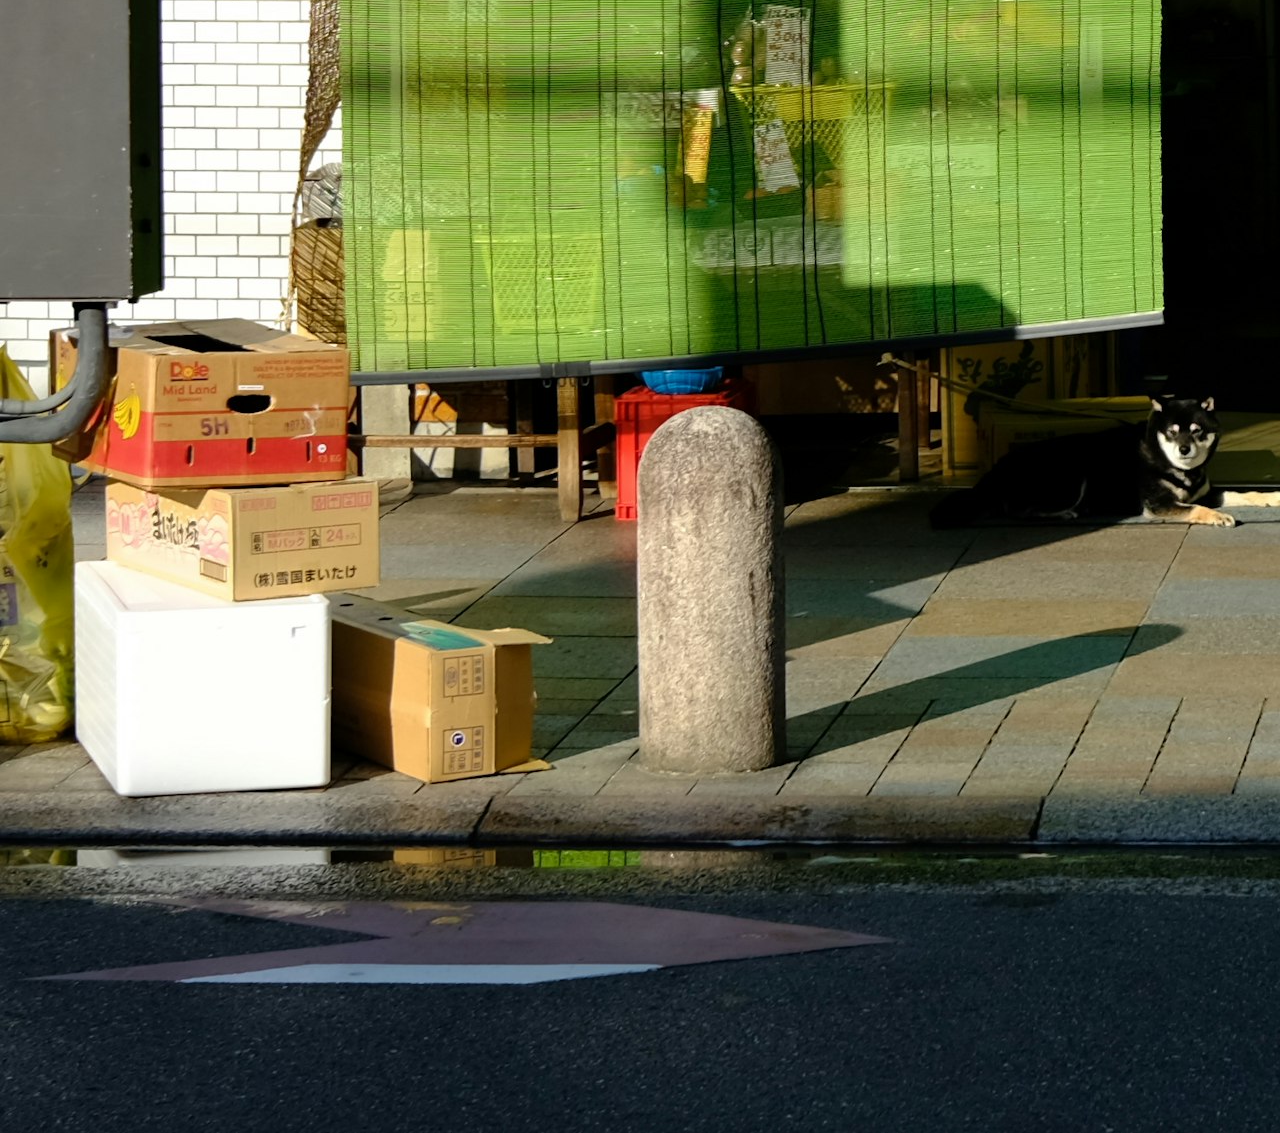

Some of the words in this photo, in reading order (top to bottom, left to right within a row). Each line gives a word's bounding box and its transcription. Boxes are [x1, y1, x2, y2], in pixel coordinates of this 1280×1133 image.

[170, 361, 210, 380] Dole
[163, 384, 186, 396] Mid
[188, 384, 217, 395] Land
[200, 418, 230, 437] 5H
[253, 564, 358, 588] (株)雪国まいたけ
